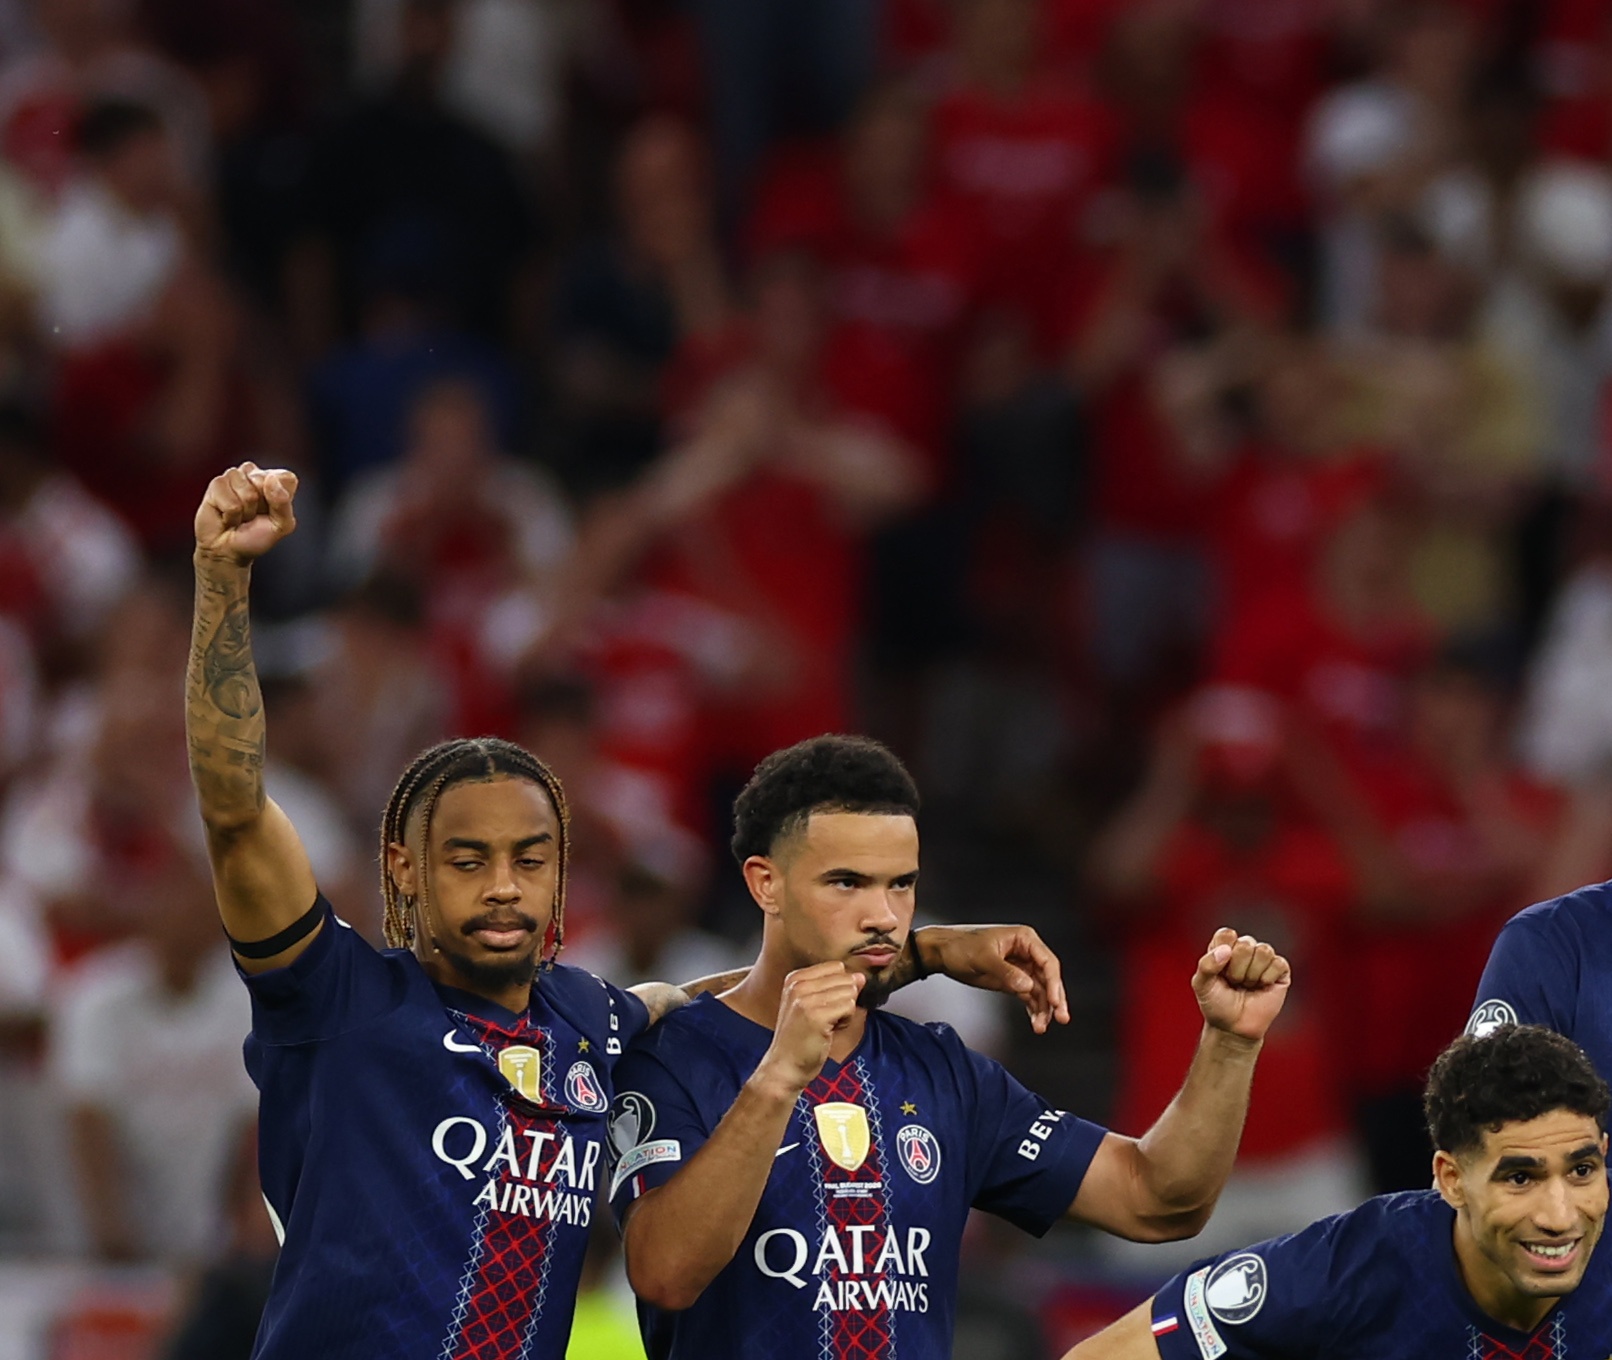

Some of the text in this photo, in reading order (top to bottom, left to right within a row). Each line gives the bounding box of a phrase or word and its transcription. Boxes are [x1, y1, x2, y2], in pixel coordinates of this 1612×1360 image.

[431, 1116, 600, 1192] QATAR
[900, 1127, 930, 1143] PARIS
[472, 1177, 592, 1228] AIRWAYS
[753, 1224, 932, 1290] QATAR
[812, 1280, 929, 1314] AIRWAYS
